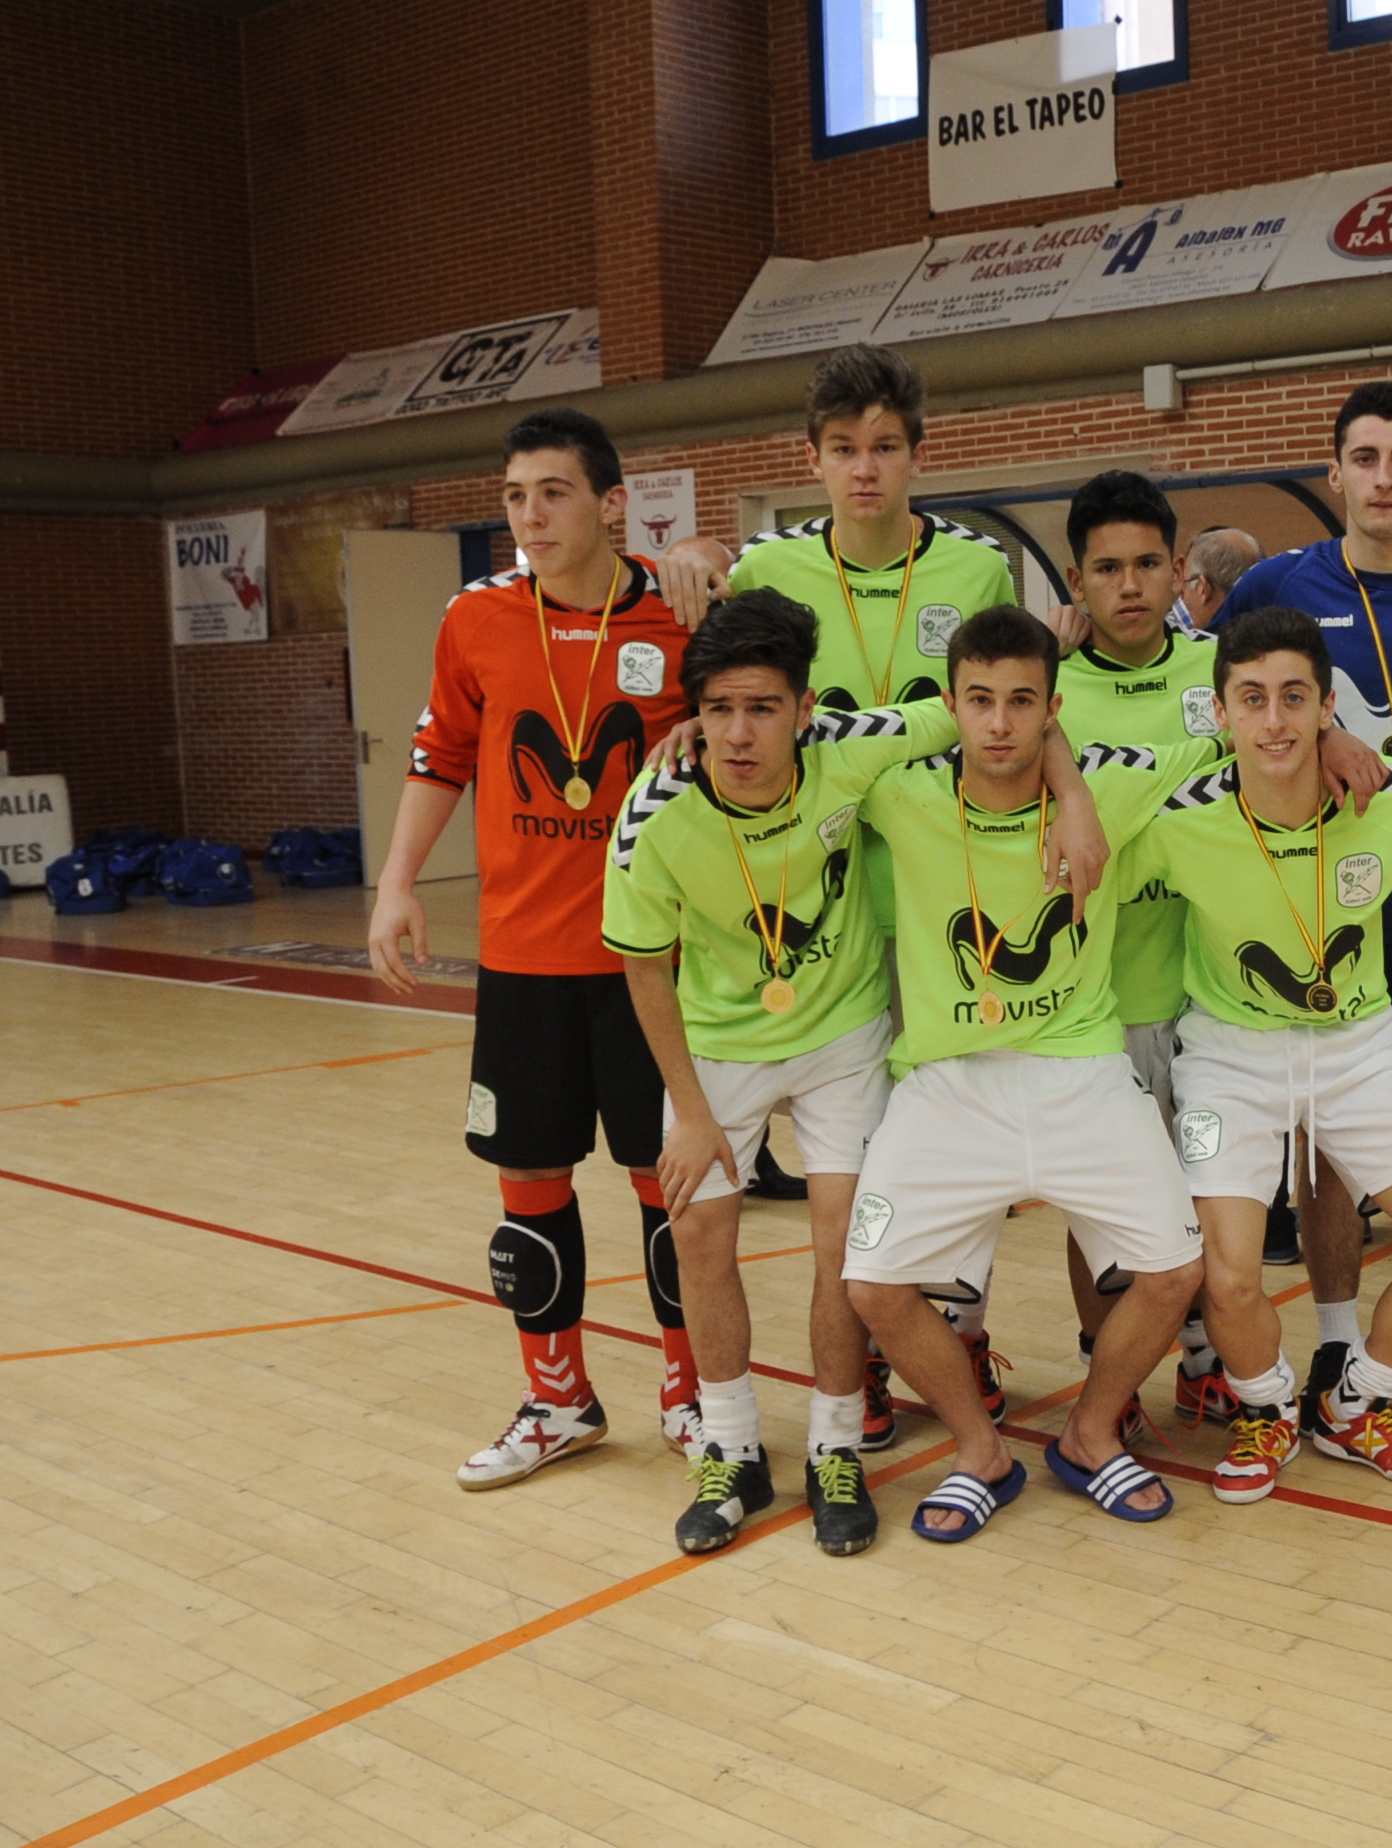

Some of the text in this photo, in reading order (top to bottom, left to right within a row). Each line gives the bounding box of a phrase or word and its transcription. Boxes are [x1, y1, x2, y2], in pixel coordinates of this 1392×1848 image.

[939, 87, 1105, 146] BAR EL TAPEO
[1251, 217, 1286, 237] MG
[960, 223, 1109, 265] IRRA & CARLOS
[971, 253, 1064, 282] CARNICERIA
[176, 534, 228, 568] BONI
[848, 584, 903, 598] humme
[926, 607, 954, 618] inter
[1315, 613, 1354, 627] ummel
[628, 644, 656, 656] inter
[1115, 677, 1167, 695] hummel
[1189, 689, 1211, 698] inter
[513, 813, 616, 840] movist
[743, 813, 802, 844] hummel
[966, 818, 1025, 833] hummel
[1345, 856, 1374, 869] inter
[1186, 1113, 1213, 1124] inter
[862, 1196, 888, 1211] inter
